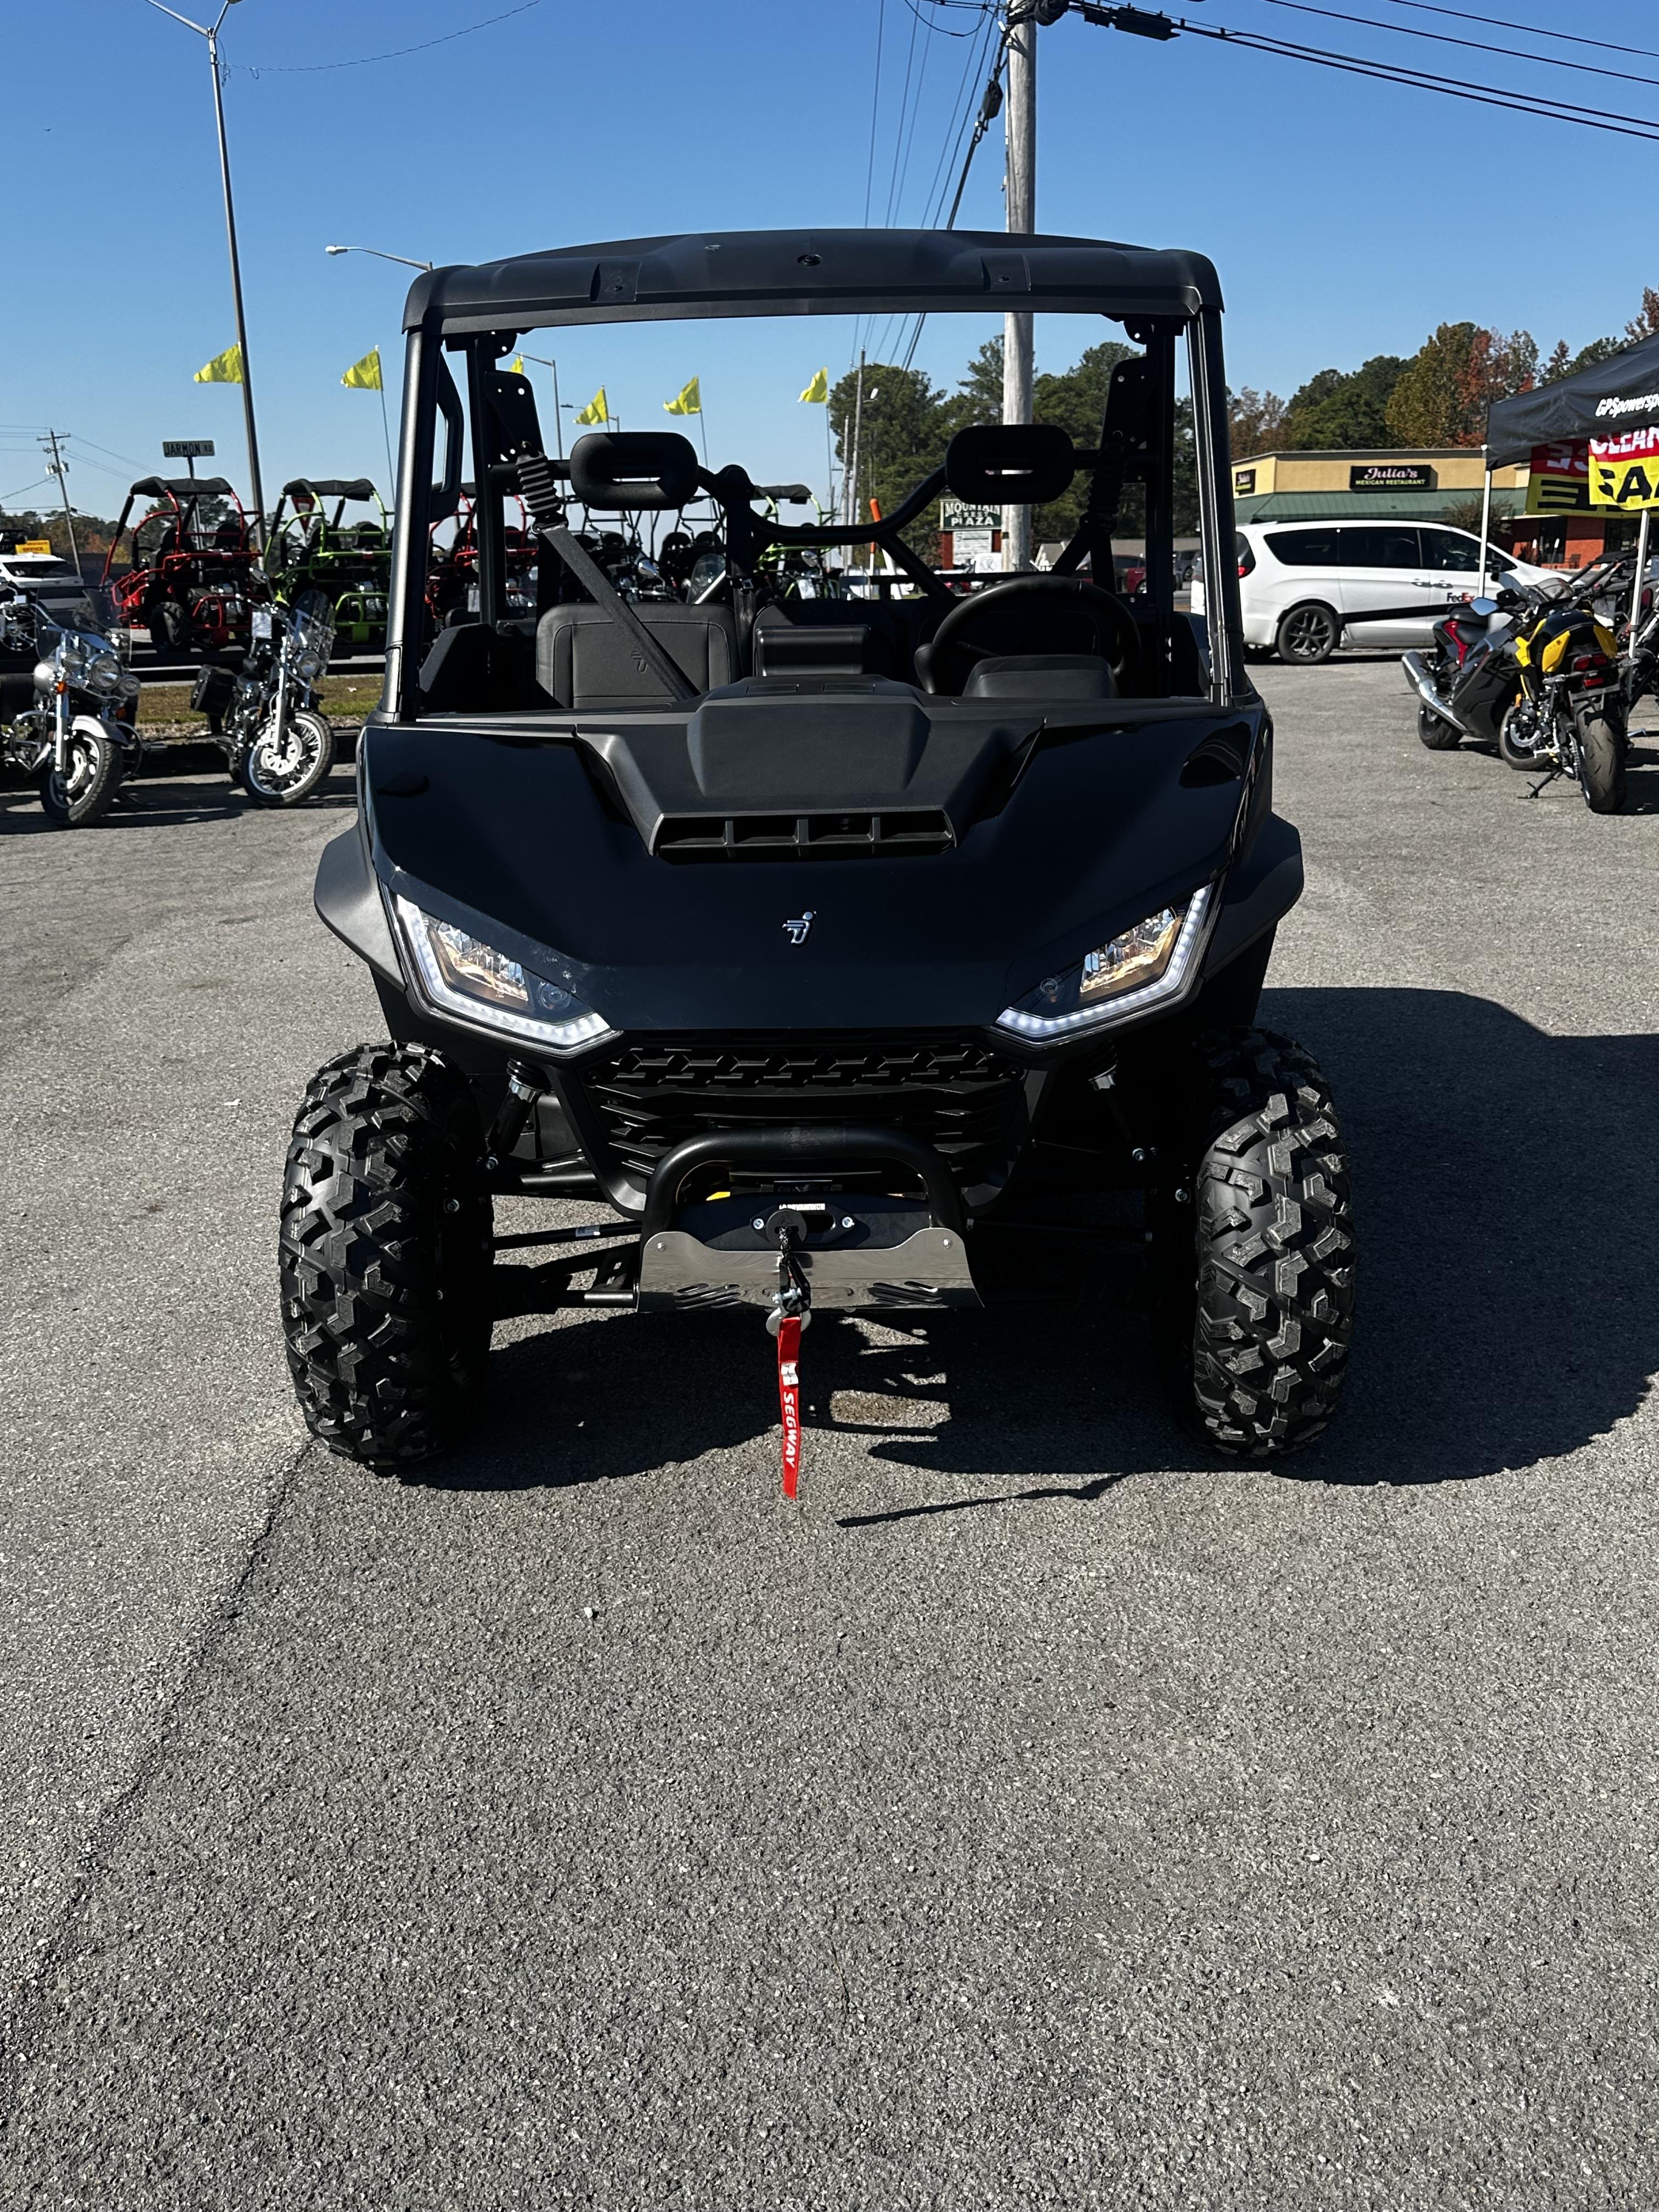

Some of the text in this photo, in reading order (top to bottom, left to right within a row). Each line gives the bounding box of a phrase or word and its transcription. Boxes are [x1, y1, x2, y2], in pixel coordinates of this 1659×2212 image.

[1595, 393, 1659, 418] GPSpowersp
[165, 443, 201, 455] JARMON
[1363, 467, 1418, 480] Julia's
[1597, 465, 1659, 503] SA
[944, 503, 1001, 517] MOUNTAIN
[950, 517, 995, 527] PLAZA
[1447, 592, 1475, 602] FedEx
[783, 1391, 798, 1469] SEGWAY
